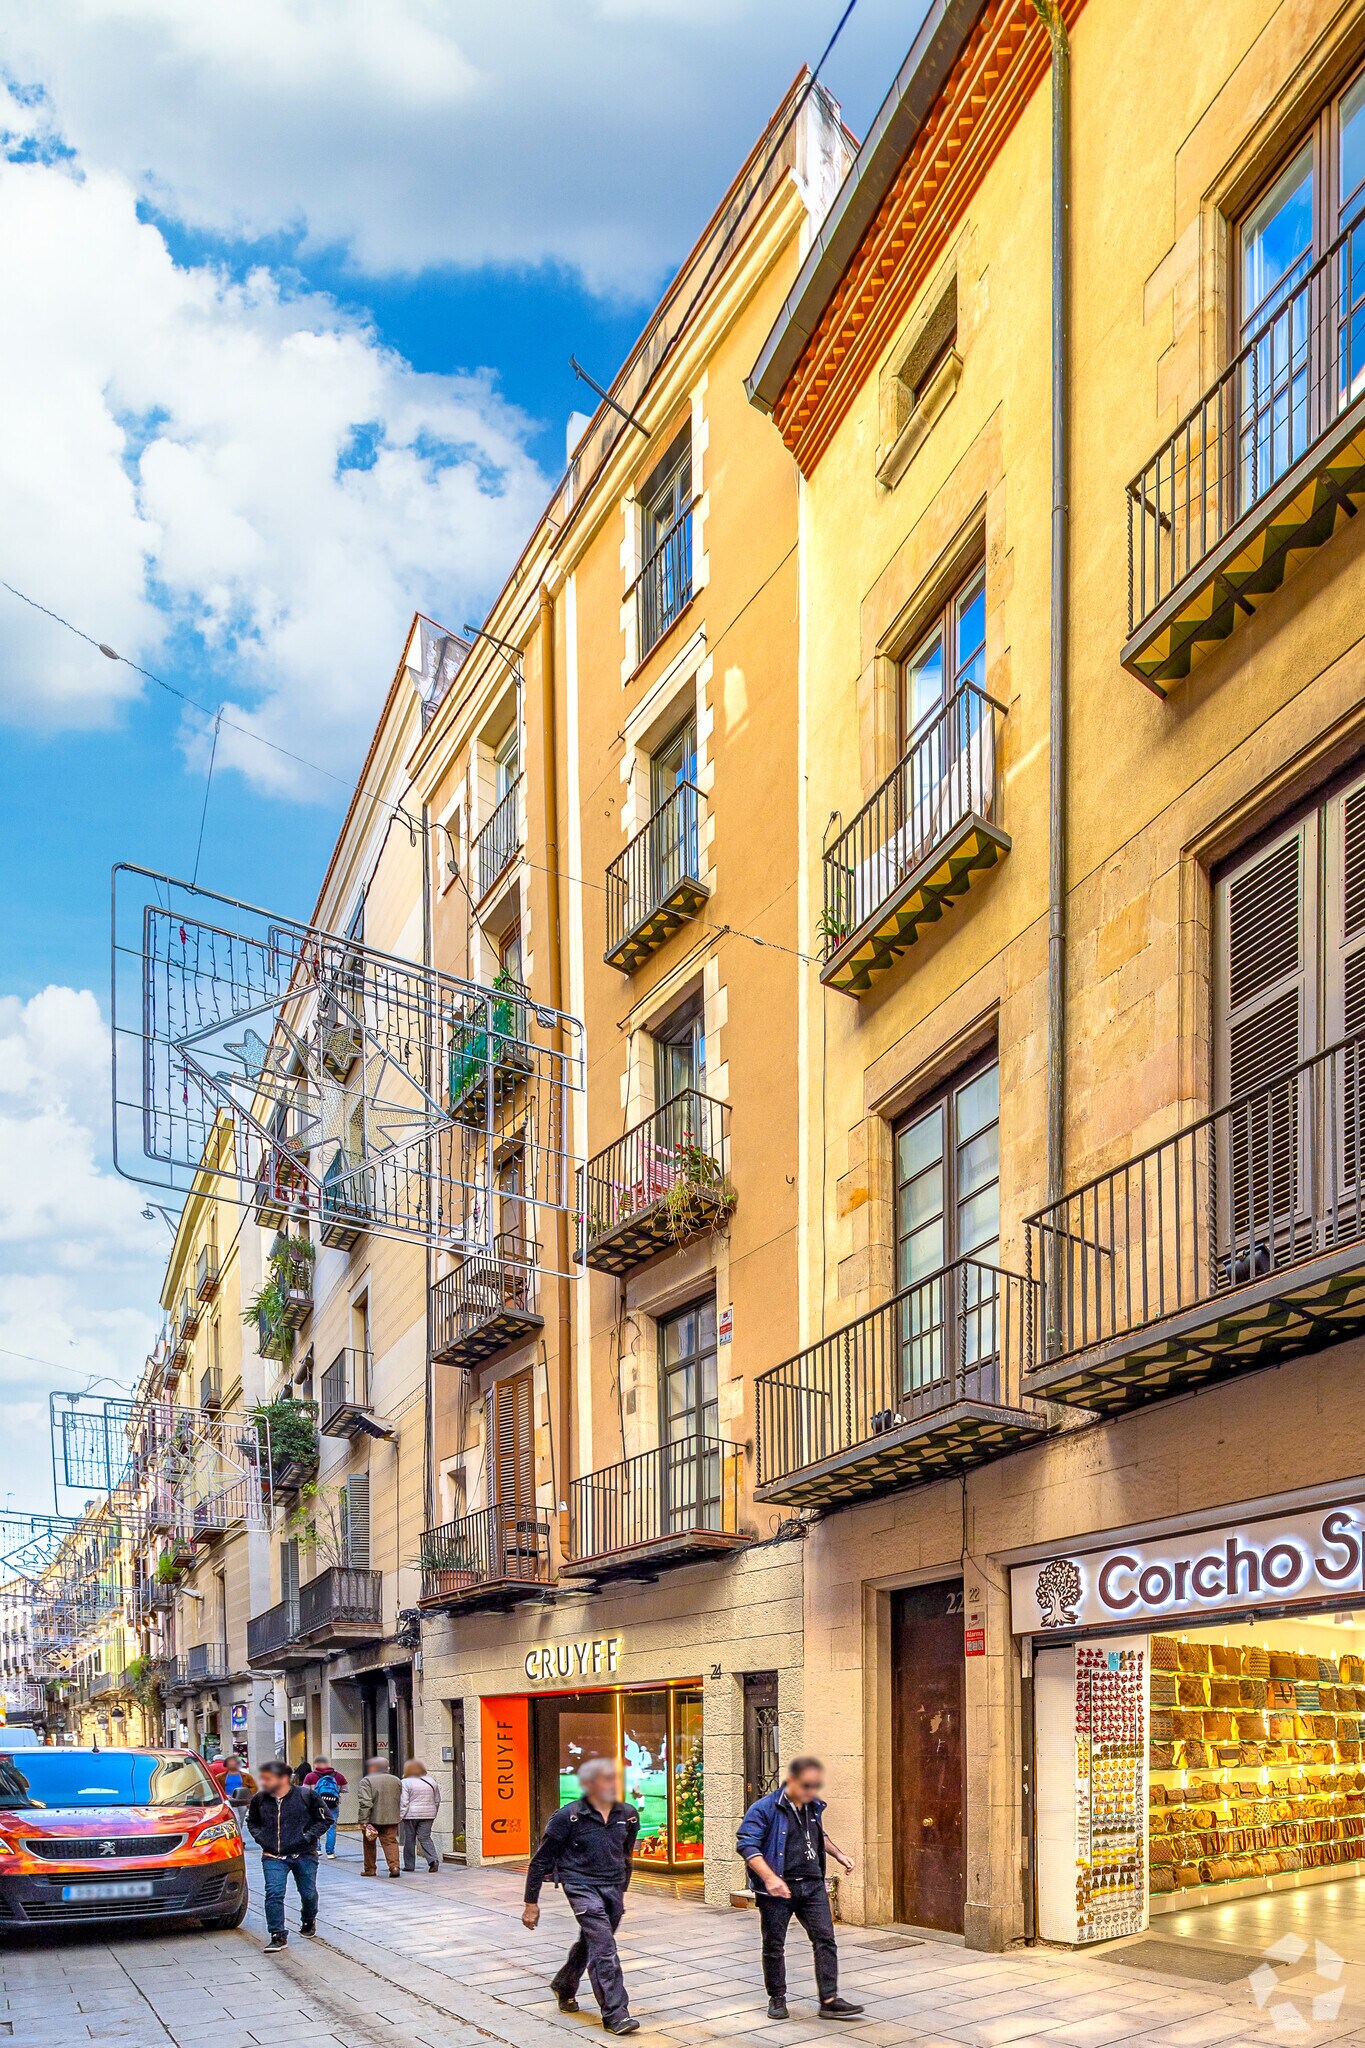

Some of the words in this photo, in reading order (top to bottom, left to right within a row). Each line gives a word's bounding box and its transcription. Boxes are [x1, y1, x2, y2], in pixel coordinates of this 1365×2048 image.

[1098, 1538, 1303, 1610] Corcho
[1314, 1512, 1365, 1591] S
[945, 1590, 965, 1615] 22
[968, 1587, 980, 1603] 22
[525, 1637, 623, 1681] CRUYFF
[710, 1663, 722, 1680] 24
[497, 1720, 514, 1800] CRUYFF
